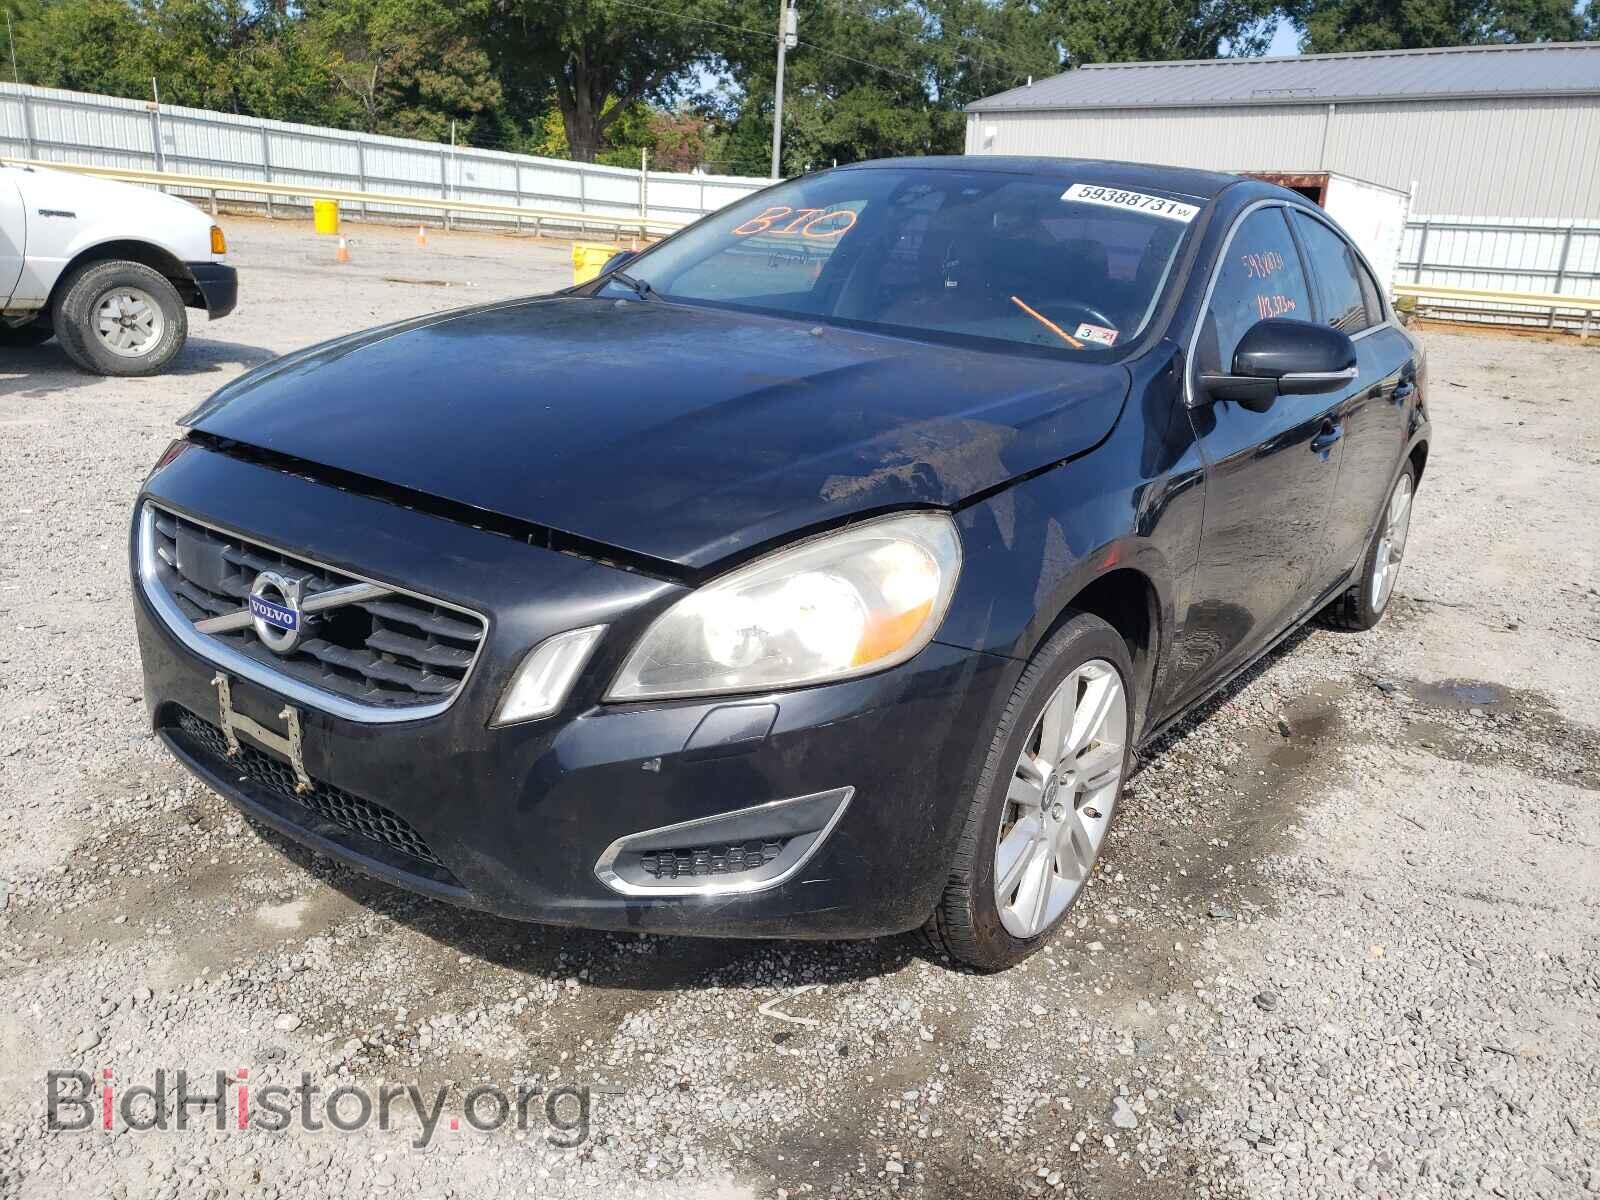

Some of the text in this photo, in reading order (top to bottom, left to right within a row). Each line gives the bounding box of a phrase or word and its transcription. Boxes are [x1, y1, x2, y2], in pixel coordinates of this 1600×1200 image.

[731, 206, 857, 238] BIO
[1081, 328, 1092, 338] 3
[251, 599, 293, 624] VOLVO
